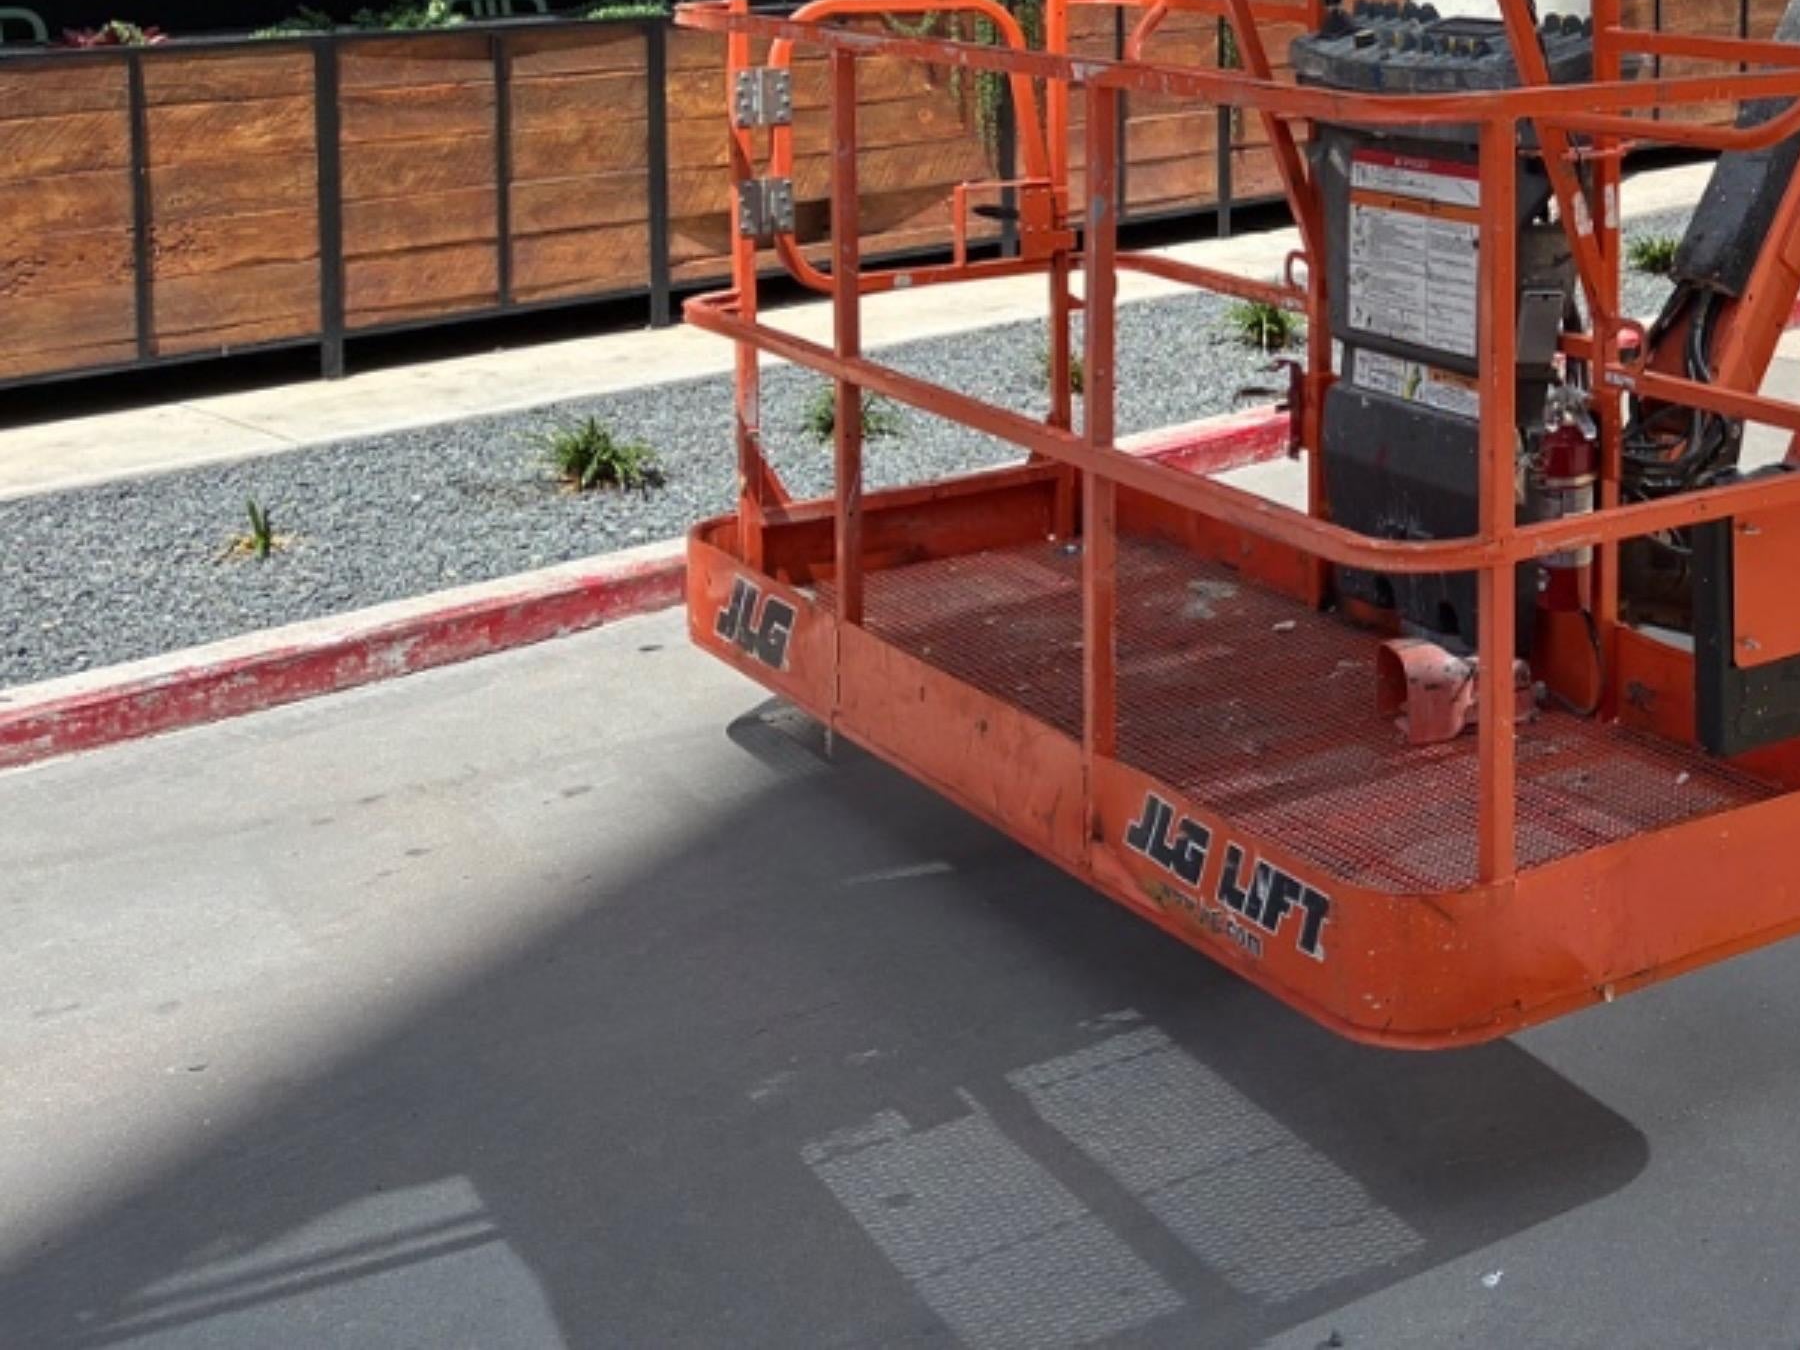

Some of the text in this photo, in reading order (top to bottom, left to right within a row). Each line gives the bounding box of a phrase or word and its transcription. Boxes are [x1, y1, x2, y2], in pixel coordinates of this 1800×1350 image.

[715, 574, 798, 672] JLG
[1124, 791, 1212, 887] JLG
[1216, 839, 1331, 962] LIFT
